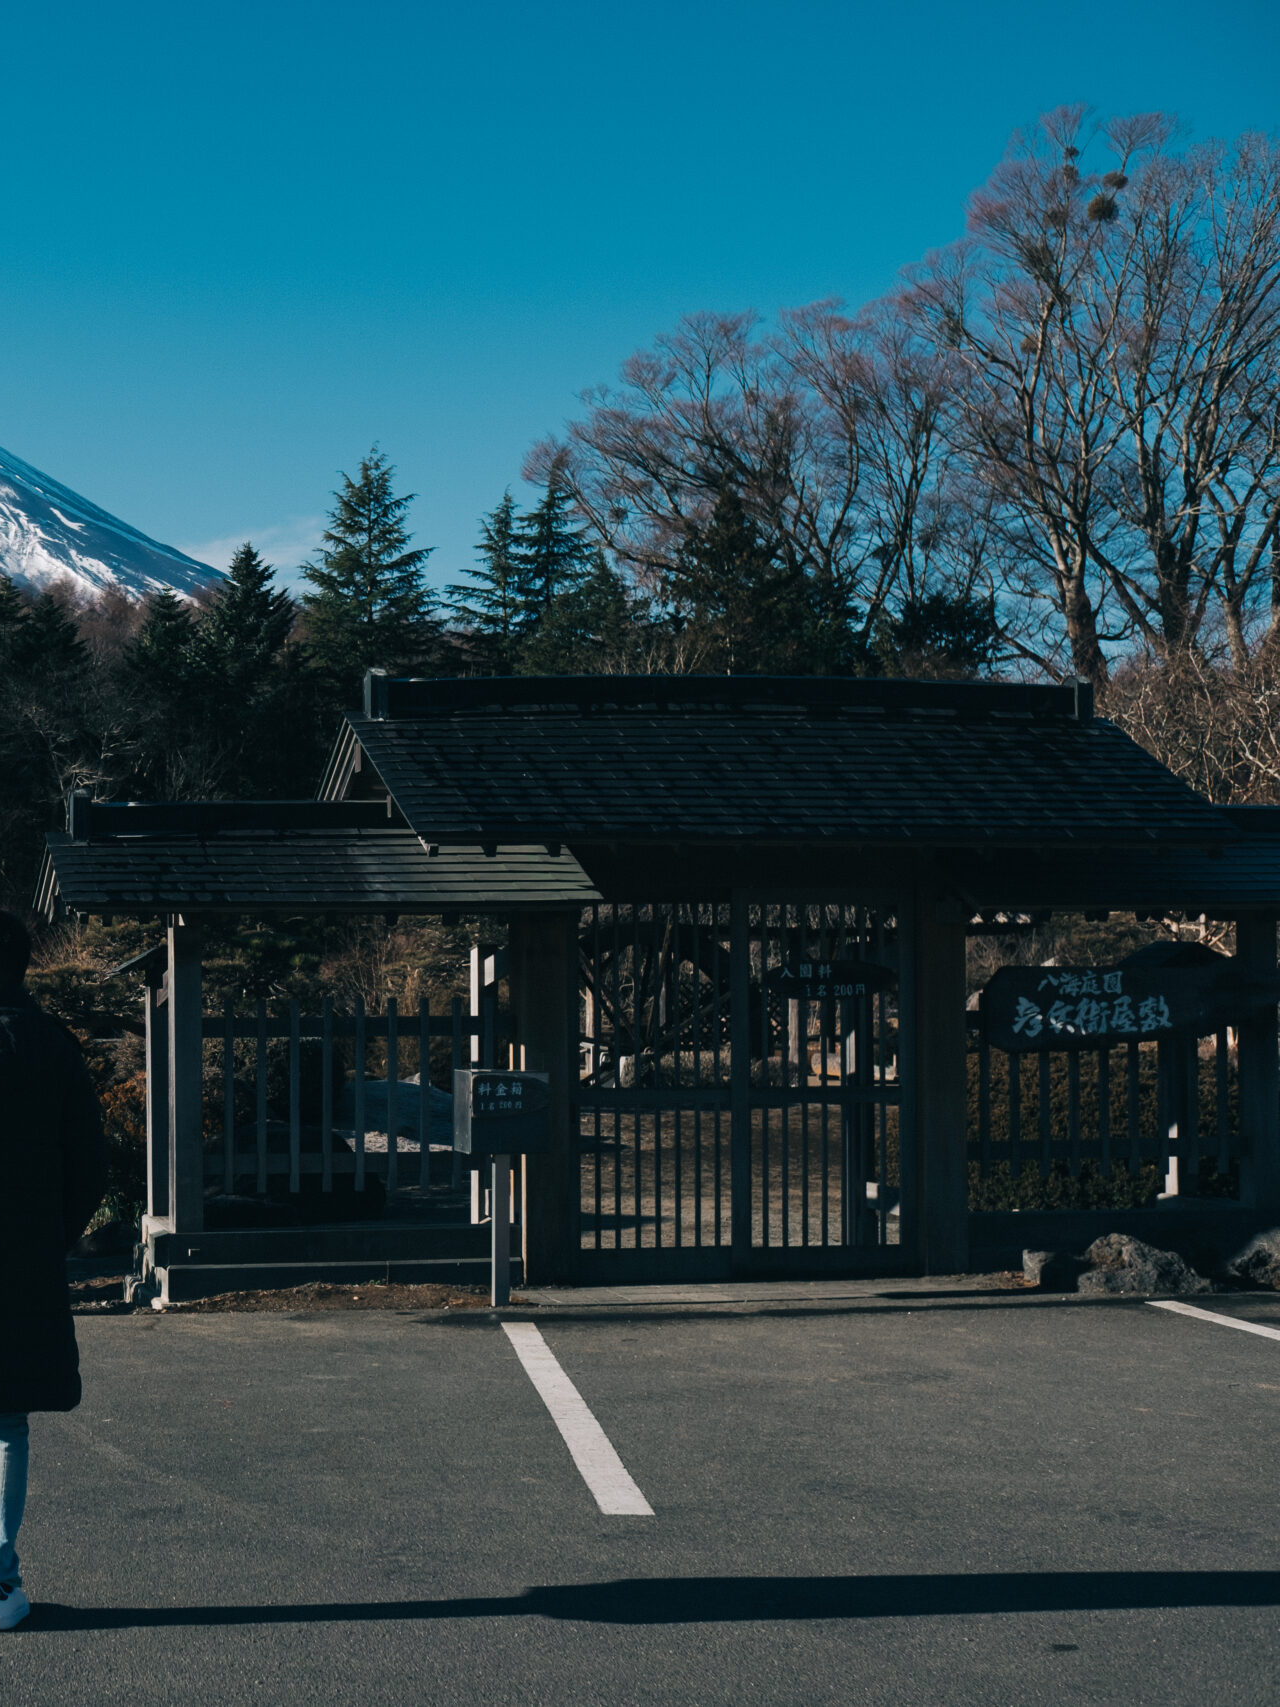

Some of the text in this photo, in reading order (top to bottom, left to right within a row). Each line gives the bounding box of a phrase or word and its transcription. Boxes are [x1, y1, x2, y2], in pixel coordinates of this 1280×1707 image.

[780, 963, 832, 979] 入園料
[478, 1082, 522, 1096] 料金箱
